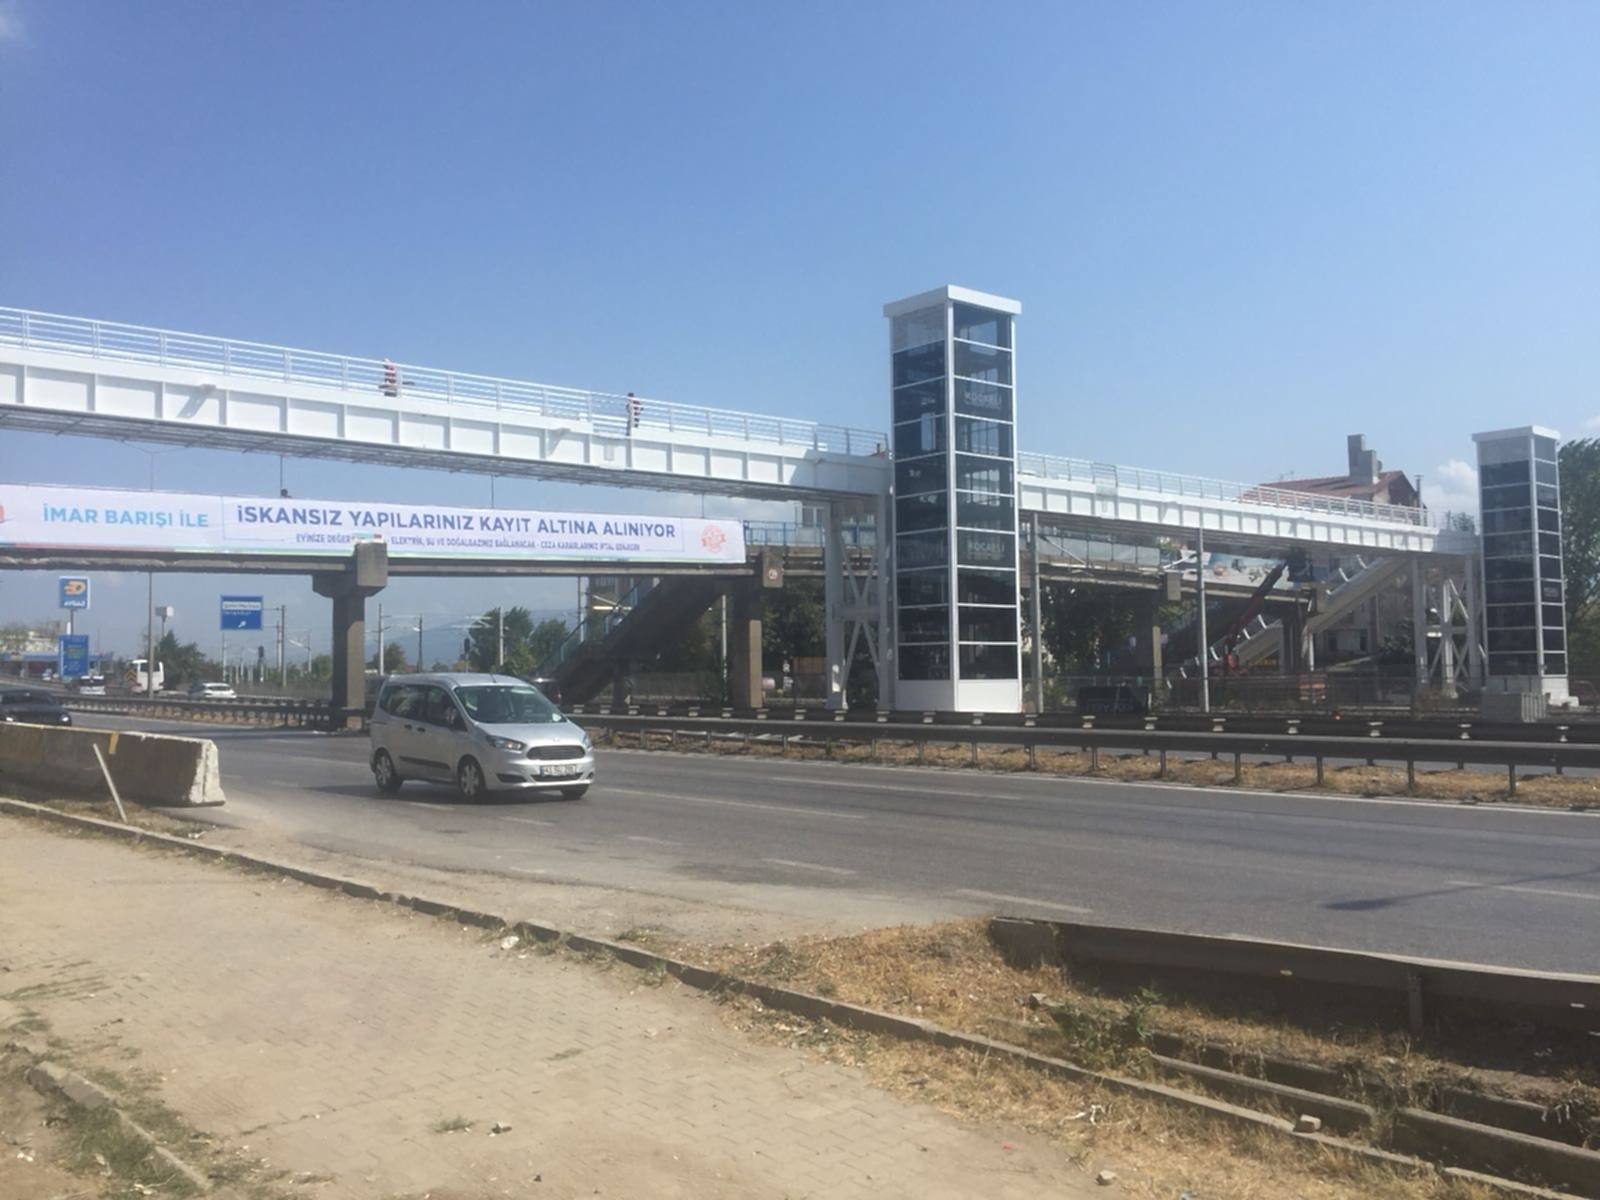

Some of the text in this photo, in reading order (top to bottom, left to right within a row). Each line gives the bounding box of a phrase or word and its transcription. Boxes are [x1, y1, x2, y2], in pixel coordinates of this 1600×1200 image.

[43, 503, 209, 528] İMAR BARIŞI İLE
[349, 510, 474, 530] YAPILARINIZ
[480, 516, 531, 532] KAYIT
[537, 518, 598, 535] ALTINA
[603, 520, 676, 538] ALINIYOR
